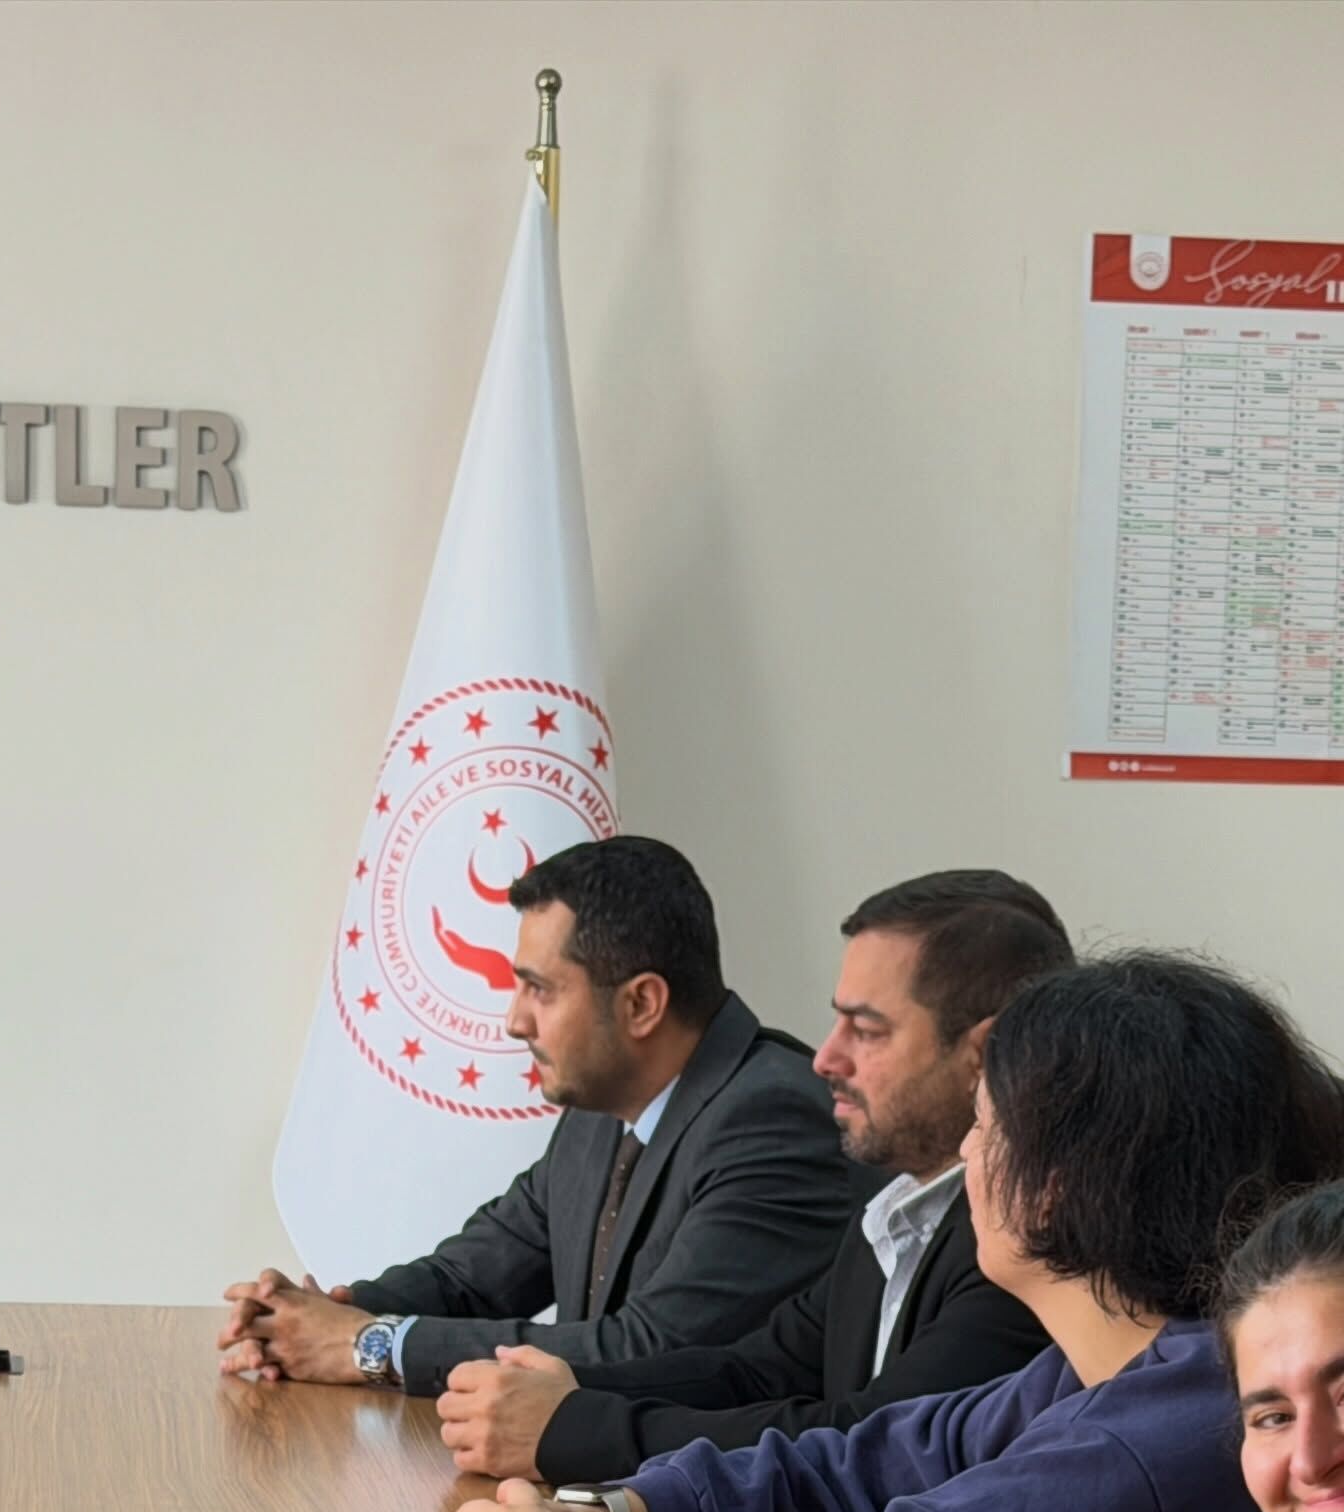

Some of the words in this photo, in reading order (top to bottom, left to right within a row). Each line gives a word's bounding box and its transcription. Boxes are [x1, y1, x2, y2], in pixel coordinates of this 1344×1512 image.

[1184, 240, 1341, 307] Sosyal
[451, 765, 480, 788] VE
[485, 759, 574, 796] SOSYAL
[416, 991, 505, 1043] TÜRKİYE
